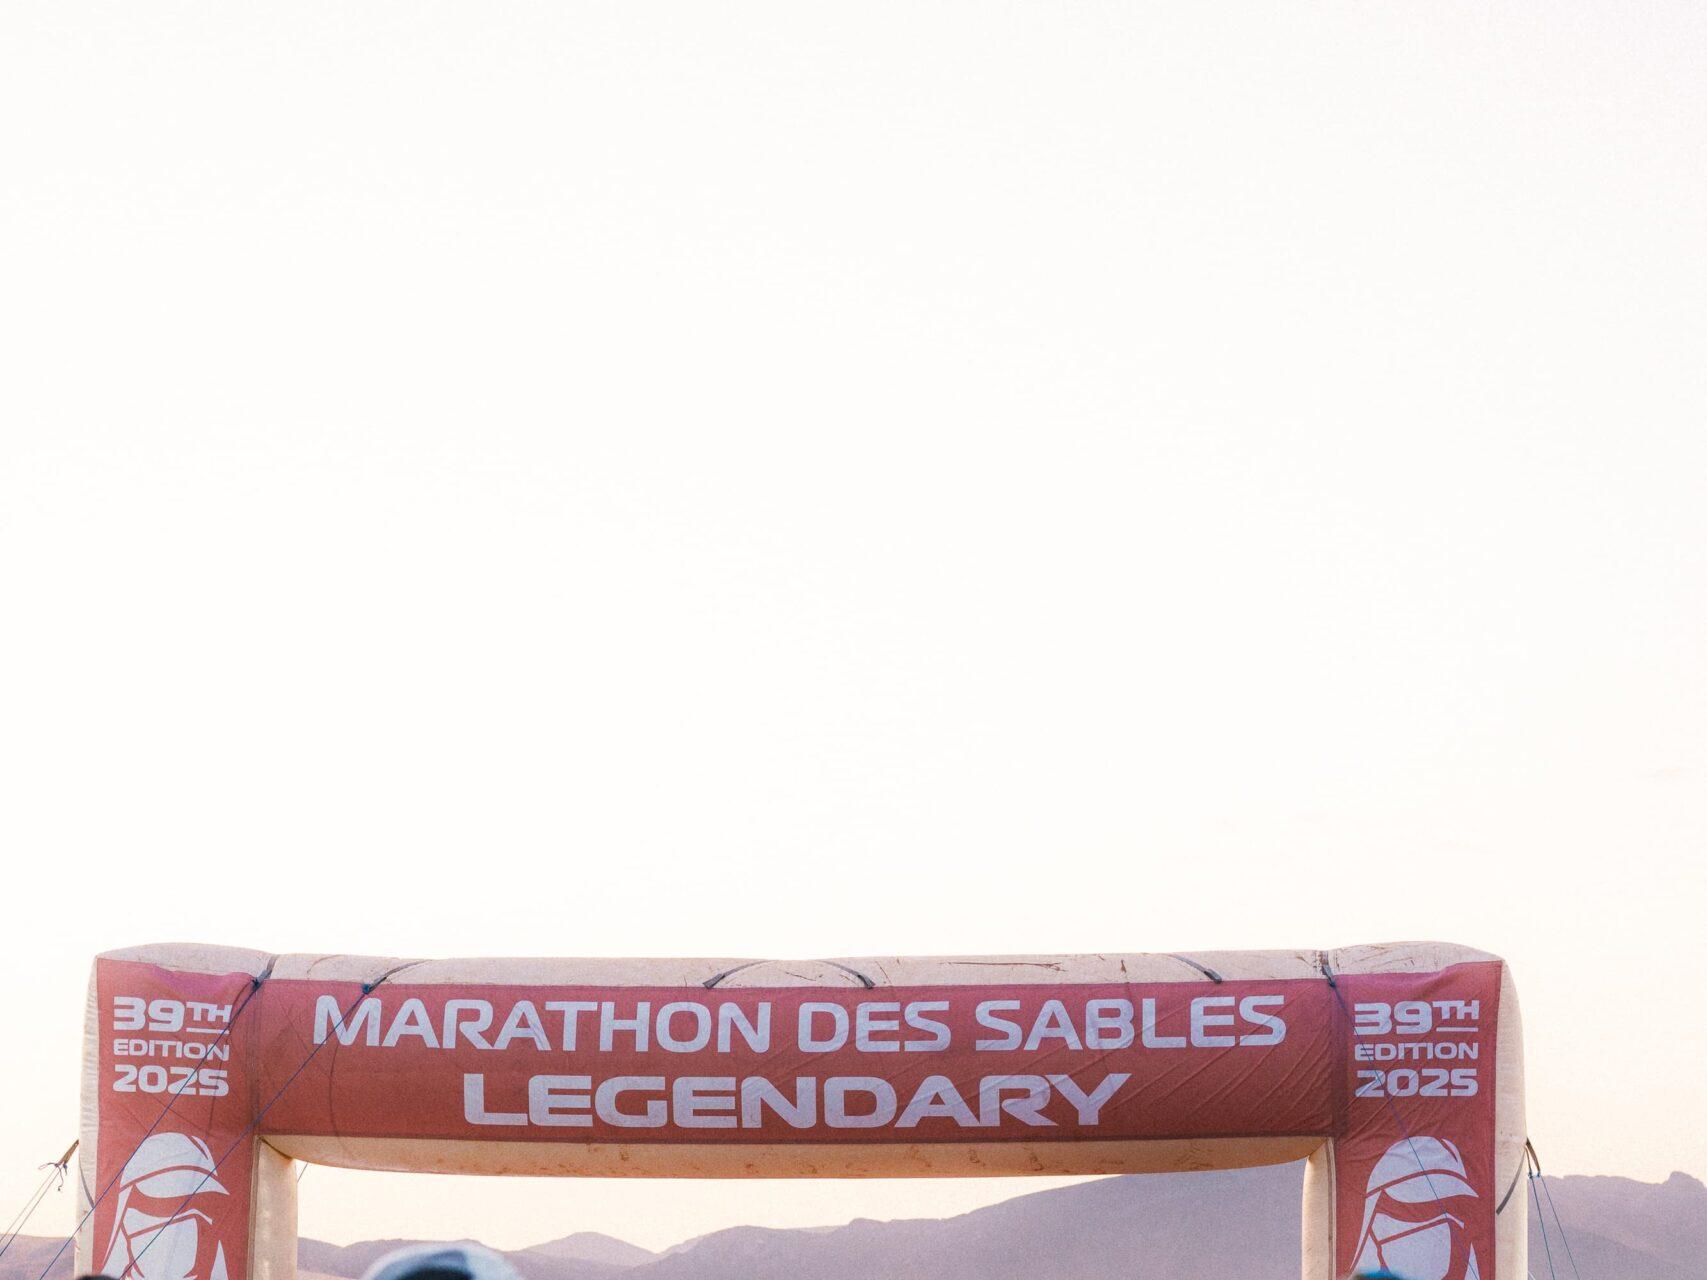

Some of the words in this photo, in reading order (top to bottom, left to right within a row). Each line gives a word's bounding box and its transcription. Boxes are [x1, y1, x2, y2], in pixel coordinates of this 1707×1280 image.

[113, 995, 233, 1034] 39TH
[313, 995, 772, 1053] MARATHON
[797, 1000, 951, 1053] DES
[975, 995, 1287, 1051] SABLES
[1353, 999, 1480, 1036] 39TH
[113, 1038, 230, 1062] EDITION
[1354, 1041, 1479, 1061] EDITION
[112, 1064, 229, 1097] 2025
[1354, 1068, 1479, 1098] 2025
[462, 1073, 1132, 1130] LEGENDARY
